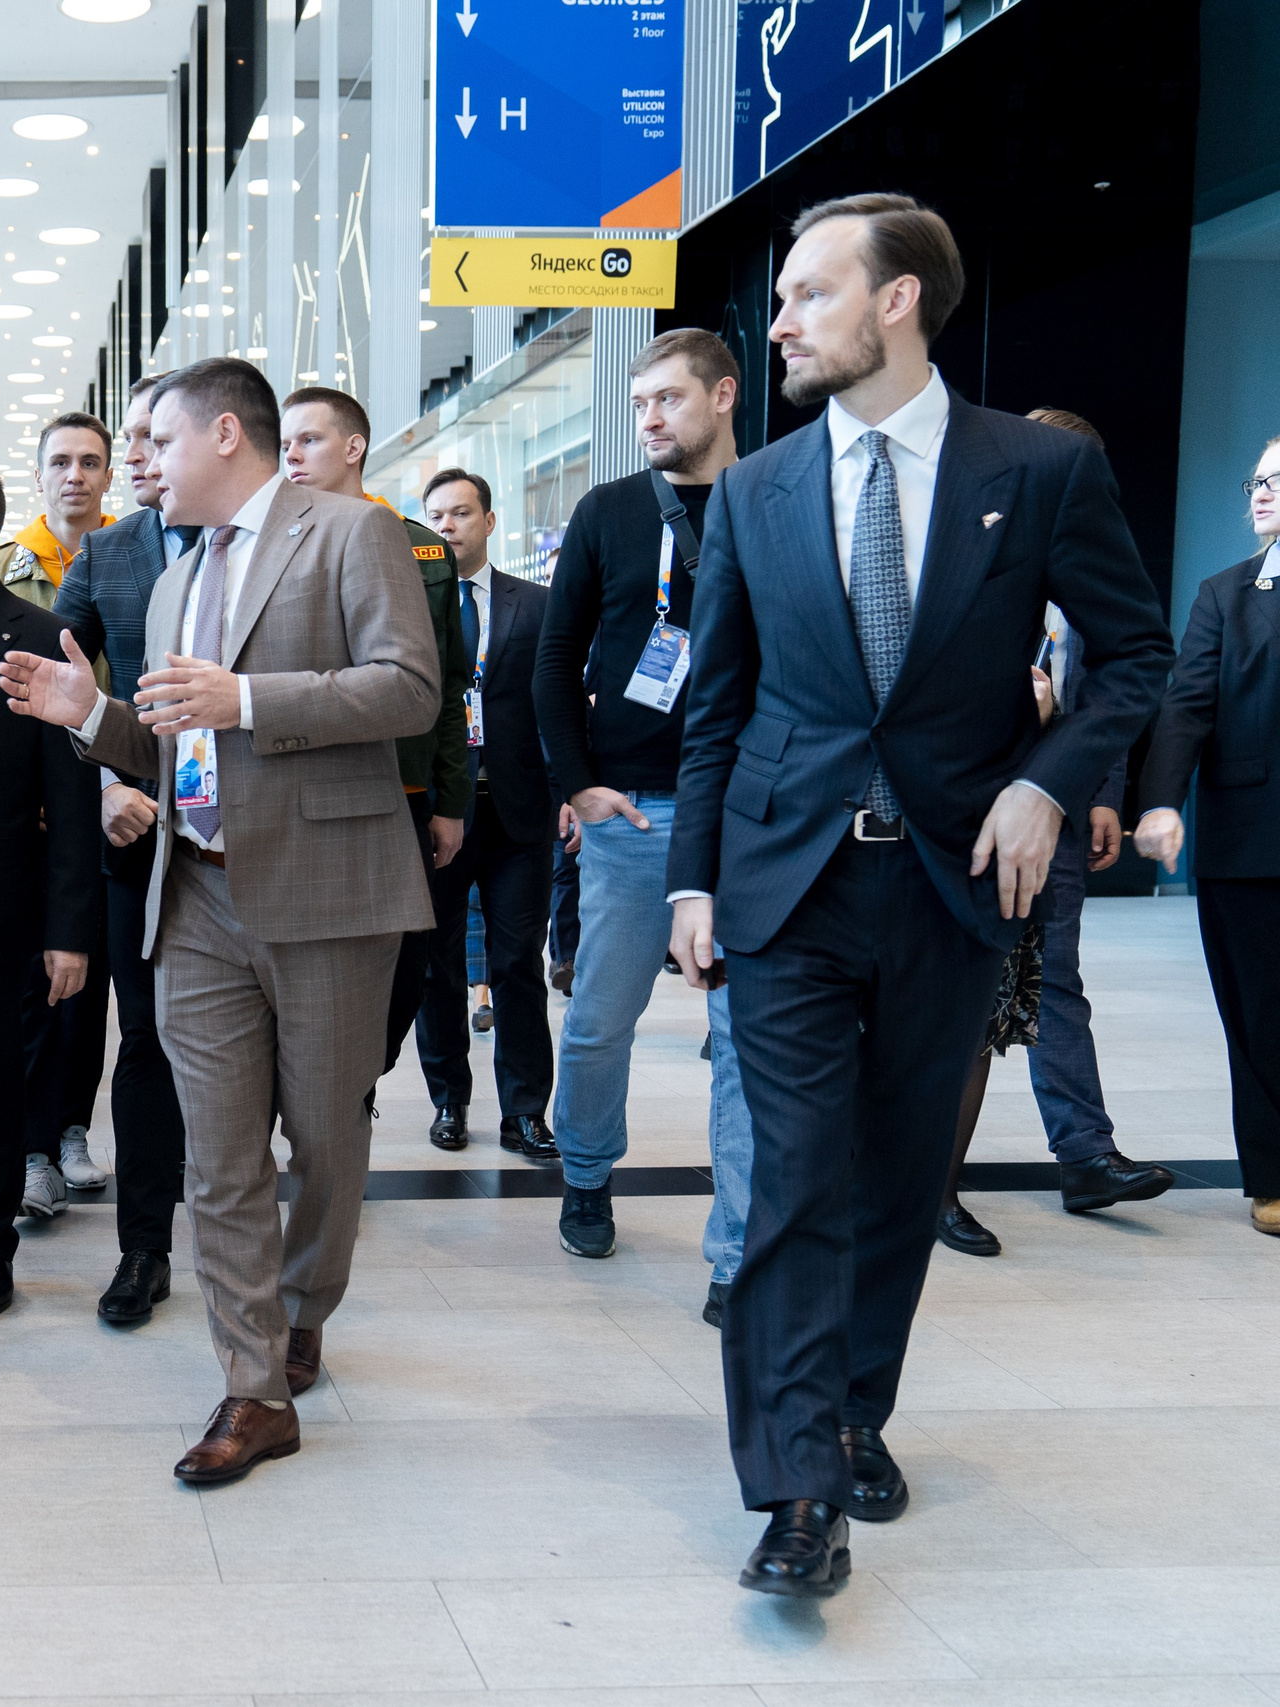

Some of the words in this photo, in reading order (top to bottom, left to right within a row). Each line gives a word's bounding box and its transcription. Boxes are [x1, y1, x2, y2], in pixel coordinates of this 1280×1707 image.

[631, 10, 639, 21] 2
[640, 11, 665, 21] этаж
[633, 27, 640, 38] 2
[641, 26, 665, 38] floor
[622, 88, 665, 98] Выставка
[622, 101, 665, 111] UTILICON
[623, 115, 665, 125] UTILICON
[643, 128, 665, 139] Expo
[530, 253, 597, 274] Яндекс
[603, 252, 630, 273] Go
[528, 285, 566, 296] МЕСТО
[567, 285, 620, 297] ПОСАДКИ
[621, 286, 628, 296] В
[630, 286, 664, 297] ТАКСИ
